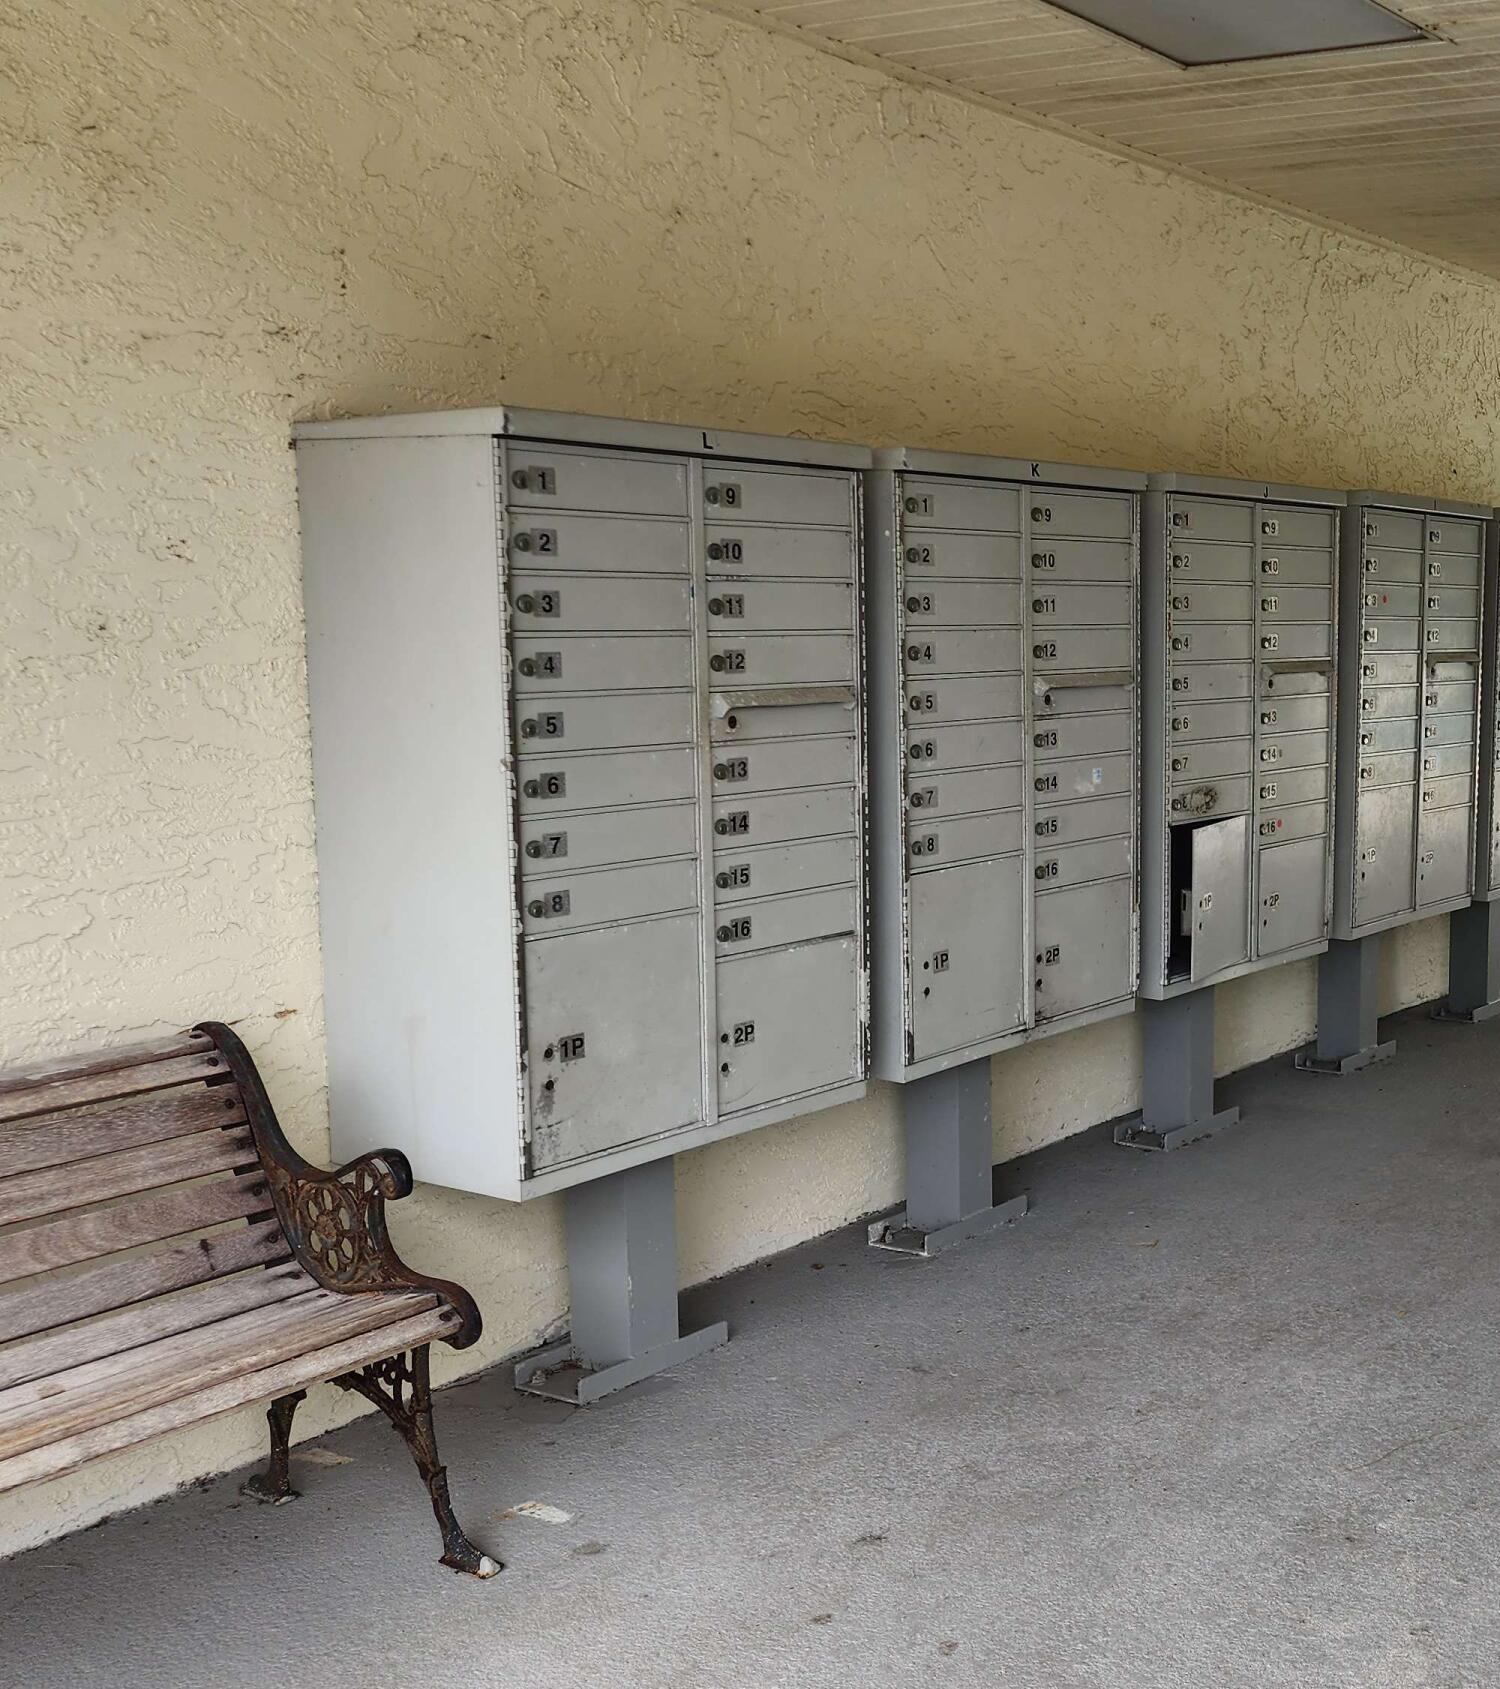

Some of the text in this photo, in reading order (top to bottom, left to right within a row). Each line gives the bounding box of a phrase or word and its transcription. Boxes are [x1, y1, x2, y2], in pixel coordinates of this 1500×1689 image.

[703, 432, 714, 450] L
[1031, 463, 1040, 476] K
[539, 472, 547, 490] 1
[726, 488, 735, 504] 9
[1264, 486, 1269, 497] J
[922, 498, 928, 512] 1
[1044, 508, 1052, 522] 9
[1184, 514, 1189, 525] 1
[1270, 523, 1276, 534] 9
[539, 534, 550, 551] 2
[723, 543, 742, 560] 10
[922, 548, 930, 563] 2
[1042, 554, 1055, 568] 10
[1183, 555, 1189, 567] 2
[1269, 560, 1278, 572] 10
[1432, 564, 1440, 575] 10
[542, 595, 553, 613] 3
[726, 599, 744, 615] 11
[923, 597, 931, 611] 3
[1043, 599, 1056, 613] 11
[1183, 596, 1189, 608] 3
[1269, 598, 1277, 610] 11
[1183, 637, 1189, 649] 4
[1269, 636, 1277, 648] 12
[923, 645, 932, 659] 4
[1043, 643, 1057, 658] 12
[543, 655, 555, 673] 4
[726, 653, 745, 670] 12
[1183, 678, 1188, 689] 5
[925, 695, 933, 710] 5
[546, 716, 557, 734] 5
[1183, 718, 1189, 729] 6
[1044, 732, 1057, 746] 13
[925, 742, 933, 757] 6
[1267, 748, 1276, 759] 14
[728, 762, 748, 778] 13
[1182, 757, 1188, 769] 7
[547, 776, 559, 794] 6
[1045, 776, 1057, 789] 14
[926, 791, 934, 805] 7
[1267, 785, 1276, 797] 15
[730, 815, 749, 832] 14
[1045, 820, 1057, 833] 15
[1266, 822, 1276, 834] 16
[549, 836, 560, 854] 7
[927, 838, 935, 852] 8
[1367, 849, 1376, 861] 1P
[1425, 852, 1433, 863] 2P
[731, 867, 749, 884] 15
[1045, 862, 1058, 876] 16
[552, 894, 563, 912] 8
[1203, 894, 1212, 908] 1P
[1269, 894, 1279, 907] 2P
[731, 920, 751, 938] 16
[934, 952, 949, 969] 1P
[1045, 947, 1060, 963] 2P
[734, 1023, 754, 1044] 2P
[560, 1037, 585, 1057] 1P
